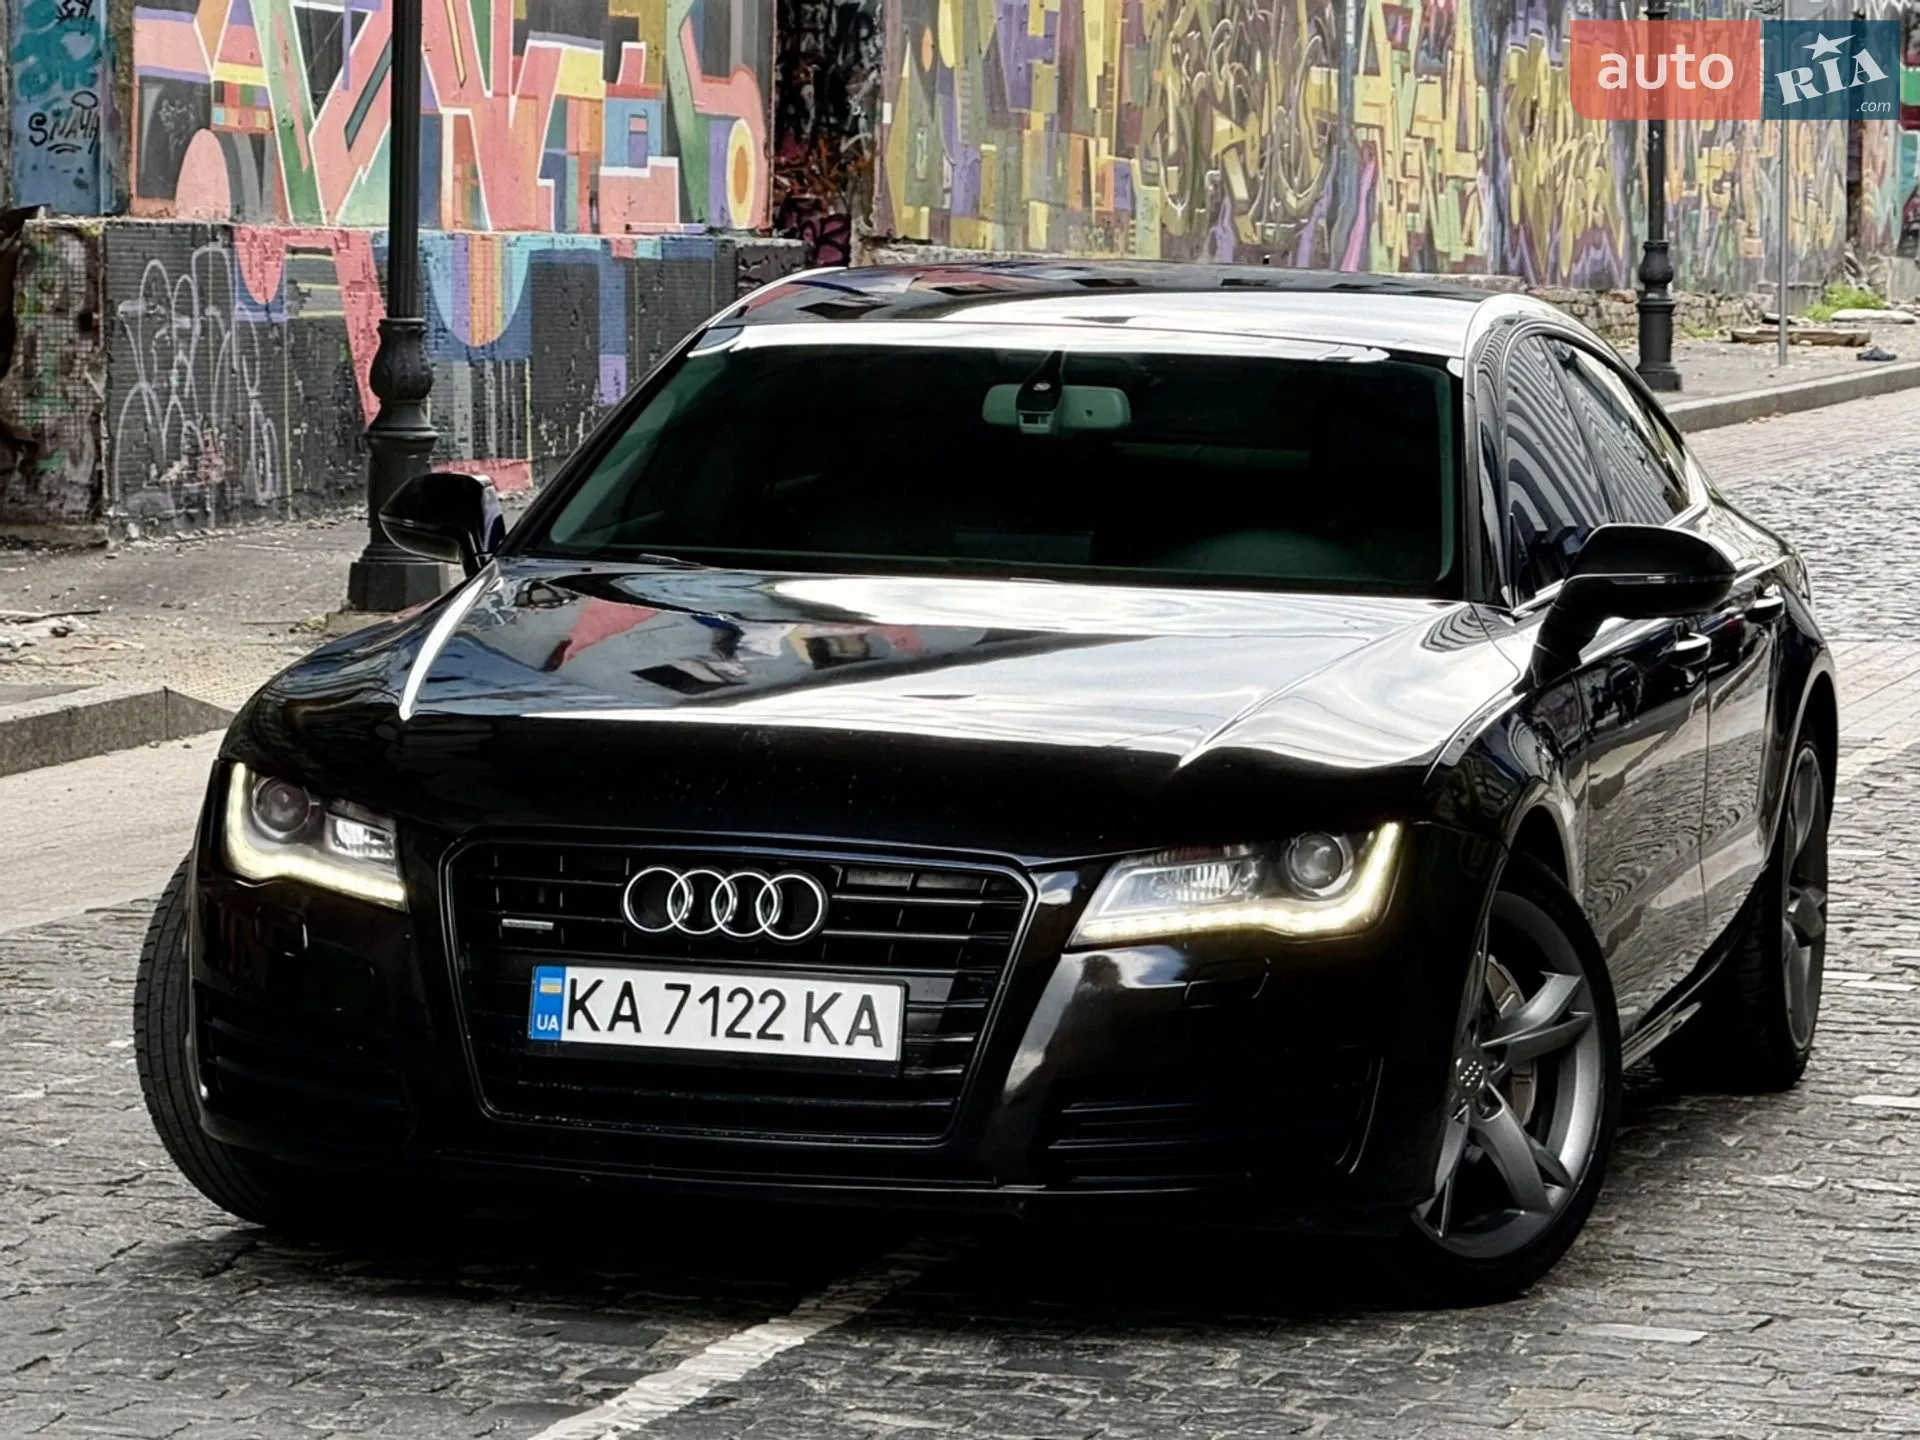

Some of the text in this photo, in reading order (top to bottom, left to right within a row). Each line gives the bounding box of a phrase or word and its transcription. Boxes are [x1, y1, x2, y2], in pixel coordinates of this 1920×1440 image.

[536, 1014, 559, 1032] UA
[567, 978, 883, 1048] KA 7122 KA
